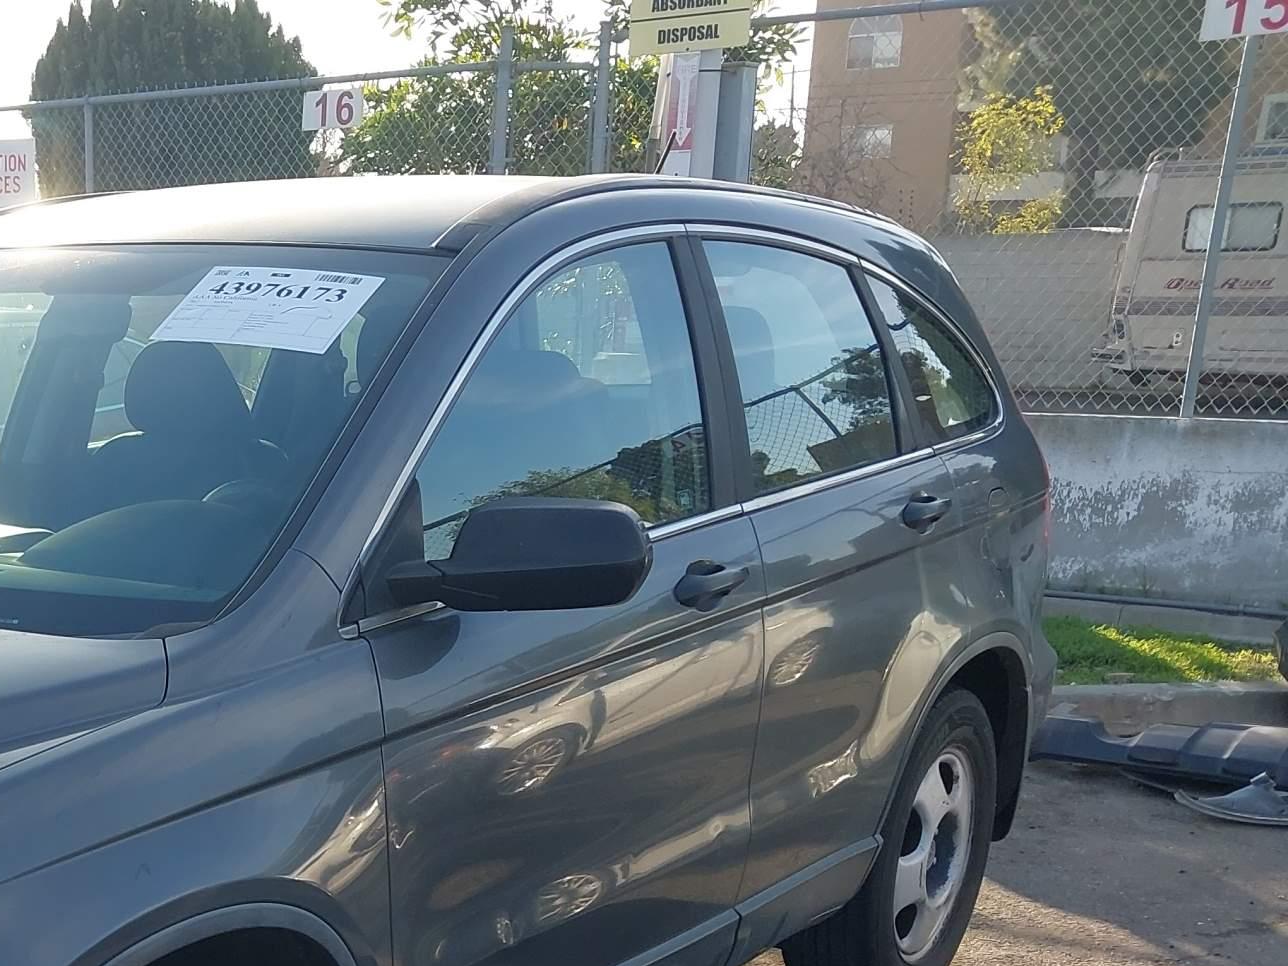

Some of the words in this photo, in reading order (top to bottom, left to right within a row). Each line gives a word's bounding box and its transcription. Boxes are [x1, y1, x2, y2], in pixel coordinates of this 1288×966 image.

[651, 0, 727, 13] ABSORB
[1225, 0, 1288, 35] 15
[657, 24, 720, 45] DISPOSAL
[315, 91, 354, 127] 16
[208, 281, 348, 303] 43976173
